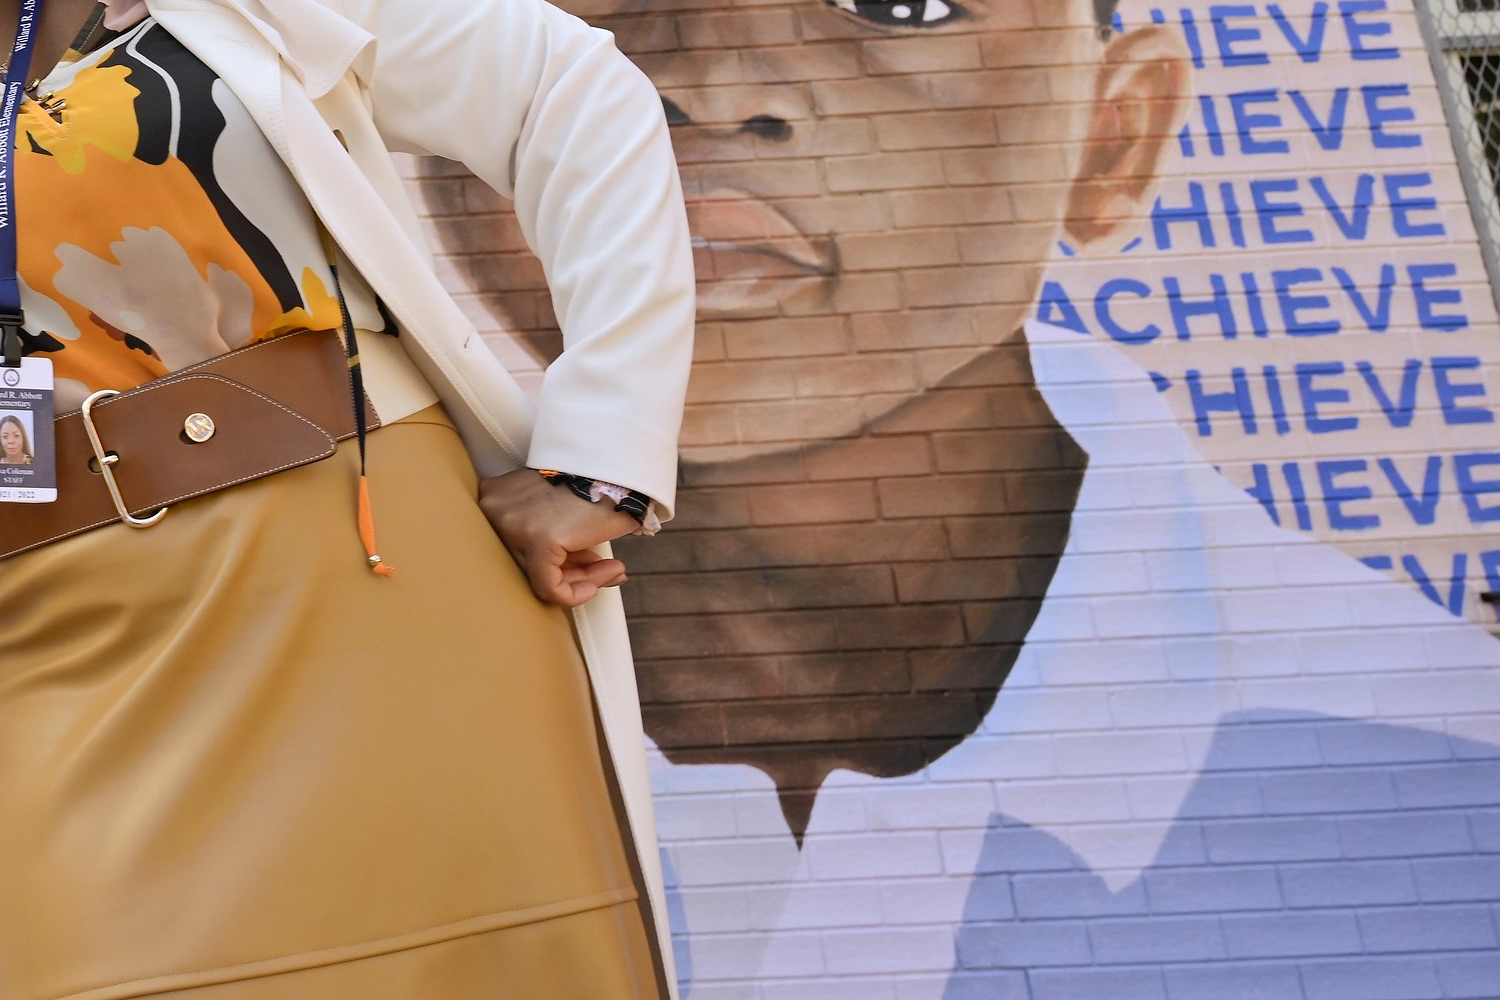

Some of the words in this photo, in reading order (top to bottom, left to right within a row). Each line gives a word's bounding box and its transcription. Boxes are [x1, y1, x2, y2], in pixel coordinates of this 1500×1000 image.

[20, 12, 34, 23] R.
[14, 22, 32, 52] Willard
[1036, 263, 1469, 345] ACHIEVE
